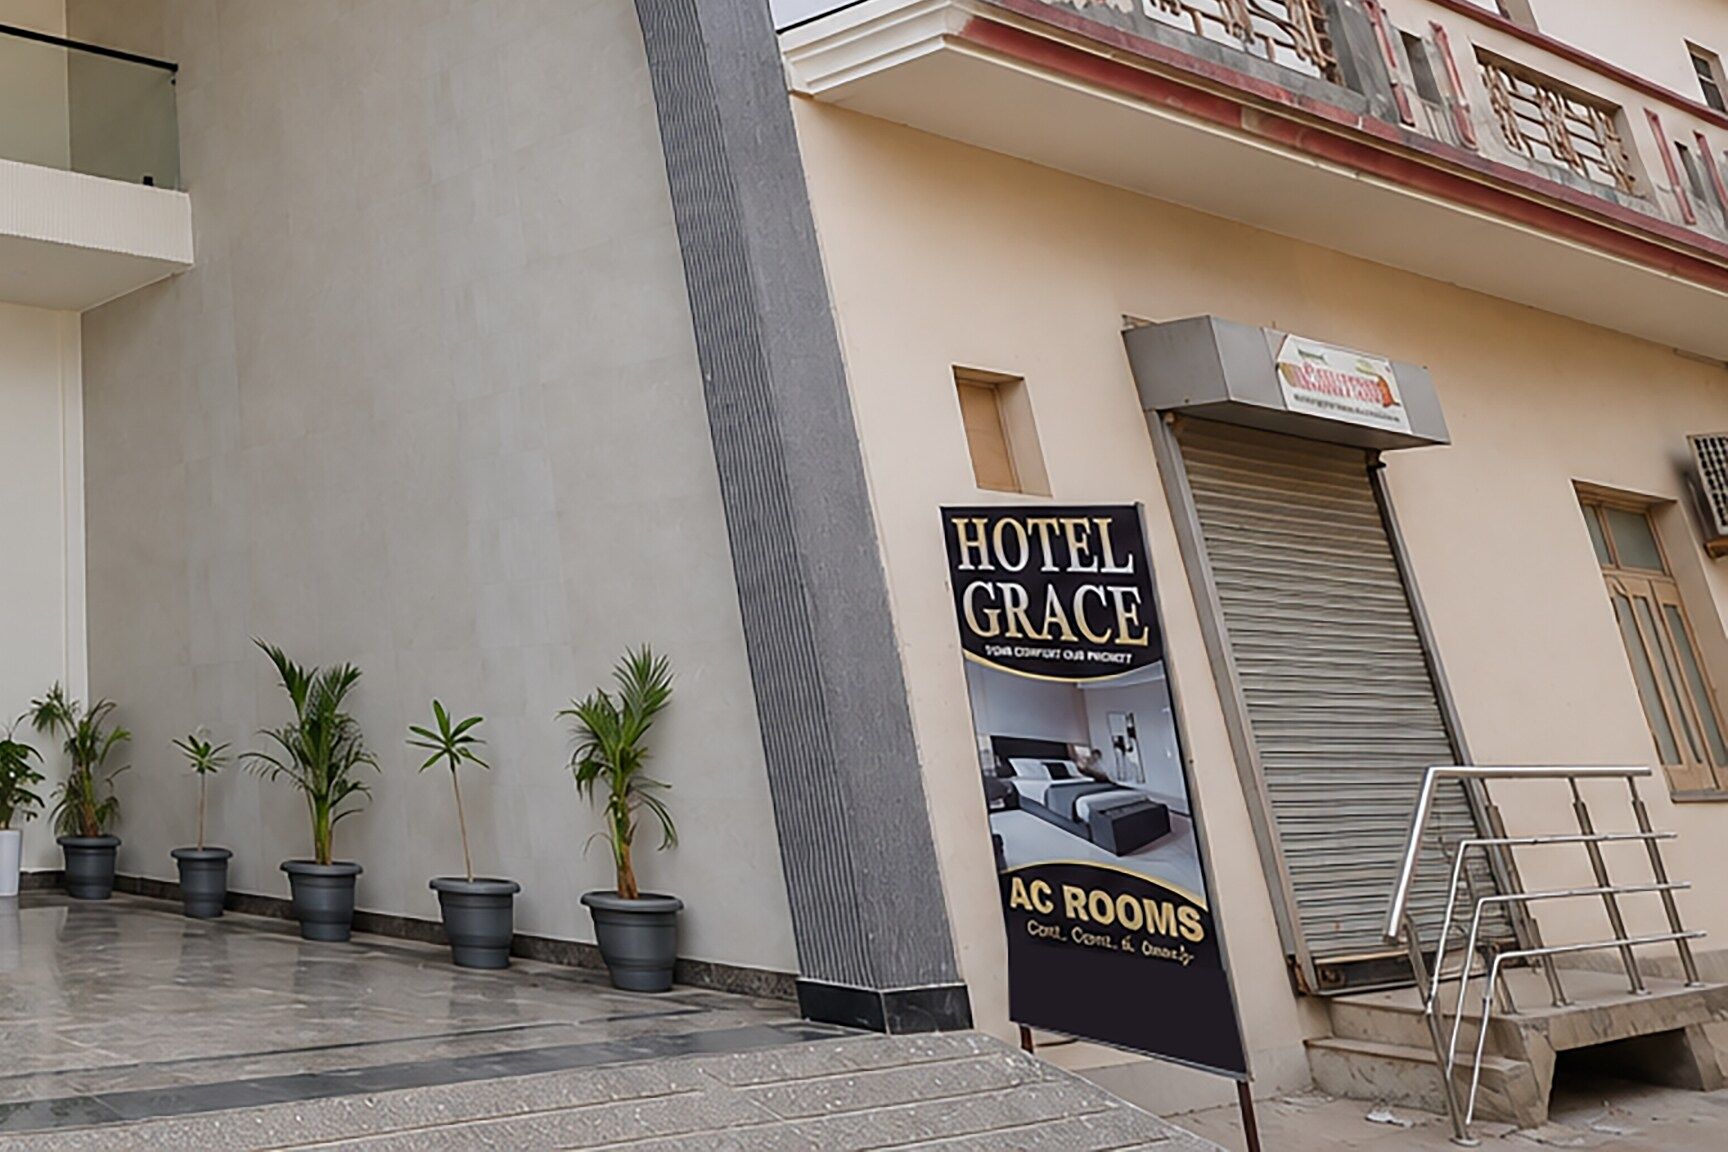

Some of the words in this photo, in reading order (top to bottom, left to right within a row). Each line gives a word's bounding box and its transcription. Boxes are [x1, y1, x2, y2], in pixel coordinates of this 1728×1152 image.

[951, 517, 1135, 574] HOTEL
[962, 580, 1149, 646] GRACE
[1009, 876, 1054, 914] AC
[1062, 884, 1205, 942] ROOMS
